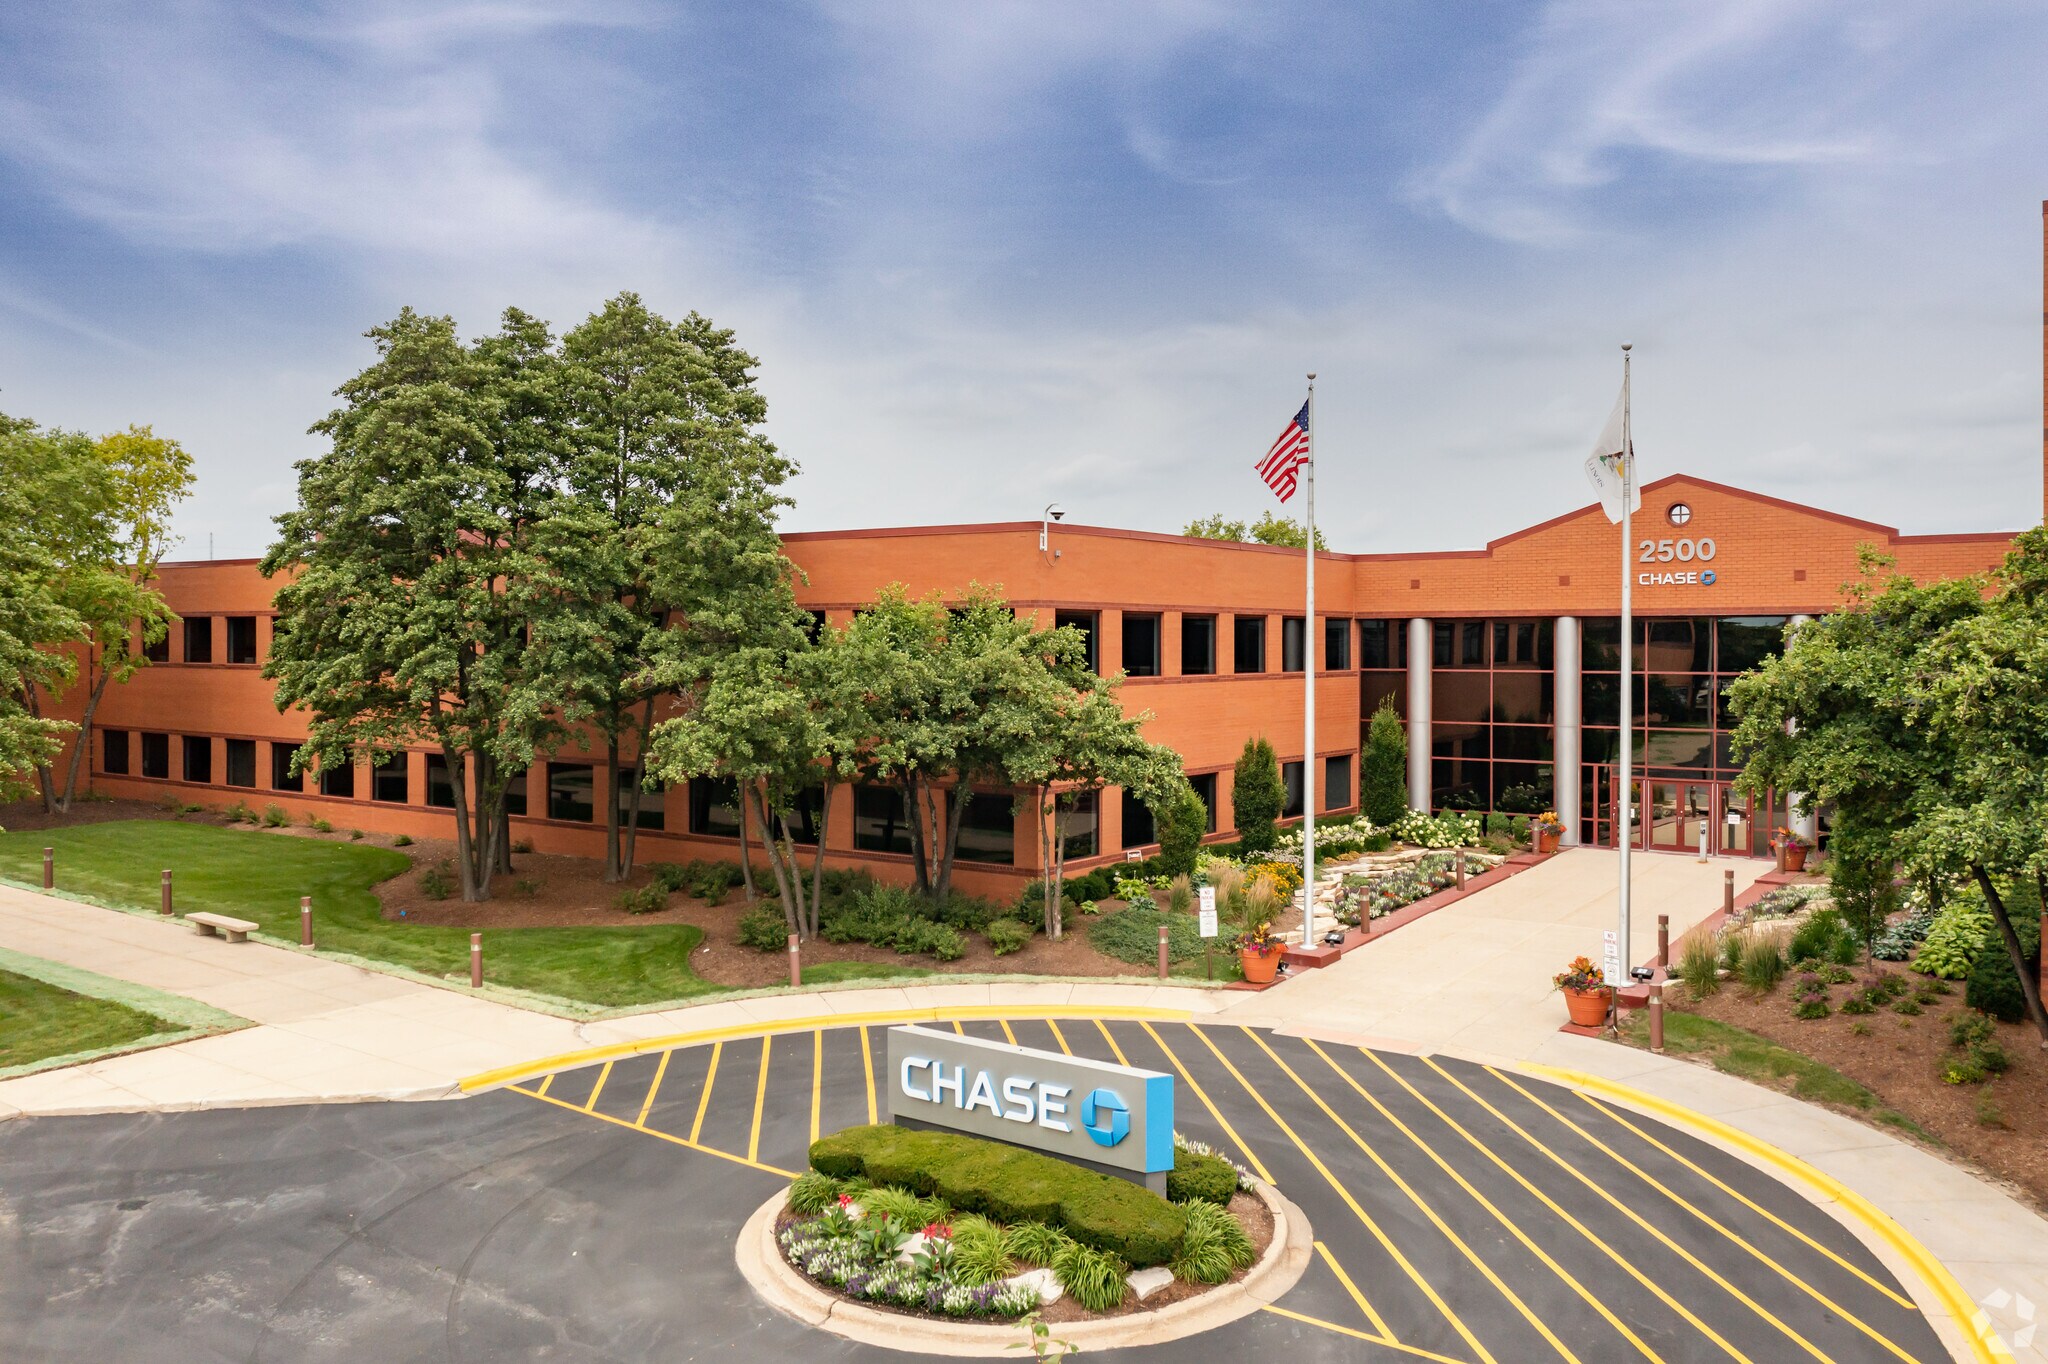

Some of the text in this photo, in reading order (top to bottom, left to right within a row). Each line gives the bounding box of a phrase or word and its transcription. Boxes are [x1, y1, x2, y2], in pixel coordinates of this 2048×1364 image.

[1639, 537, 1716, 563] 2500
[1638, 571, 1698, 586] CHASE
[901, 1056, 1072, 1133] CHASE
